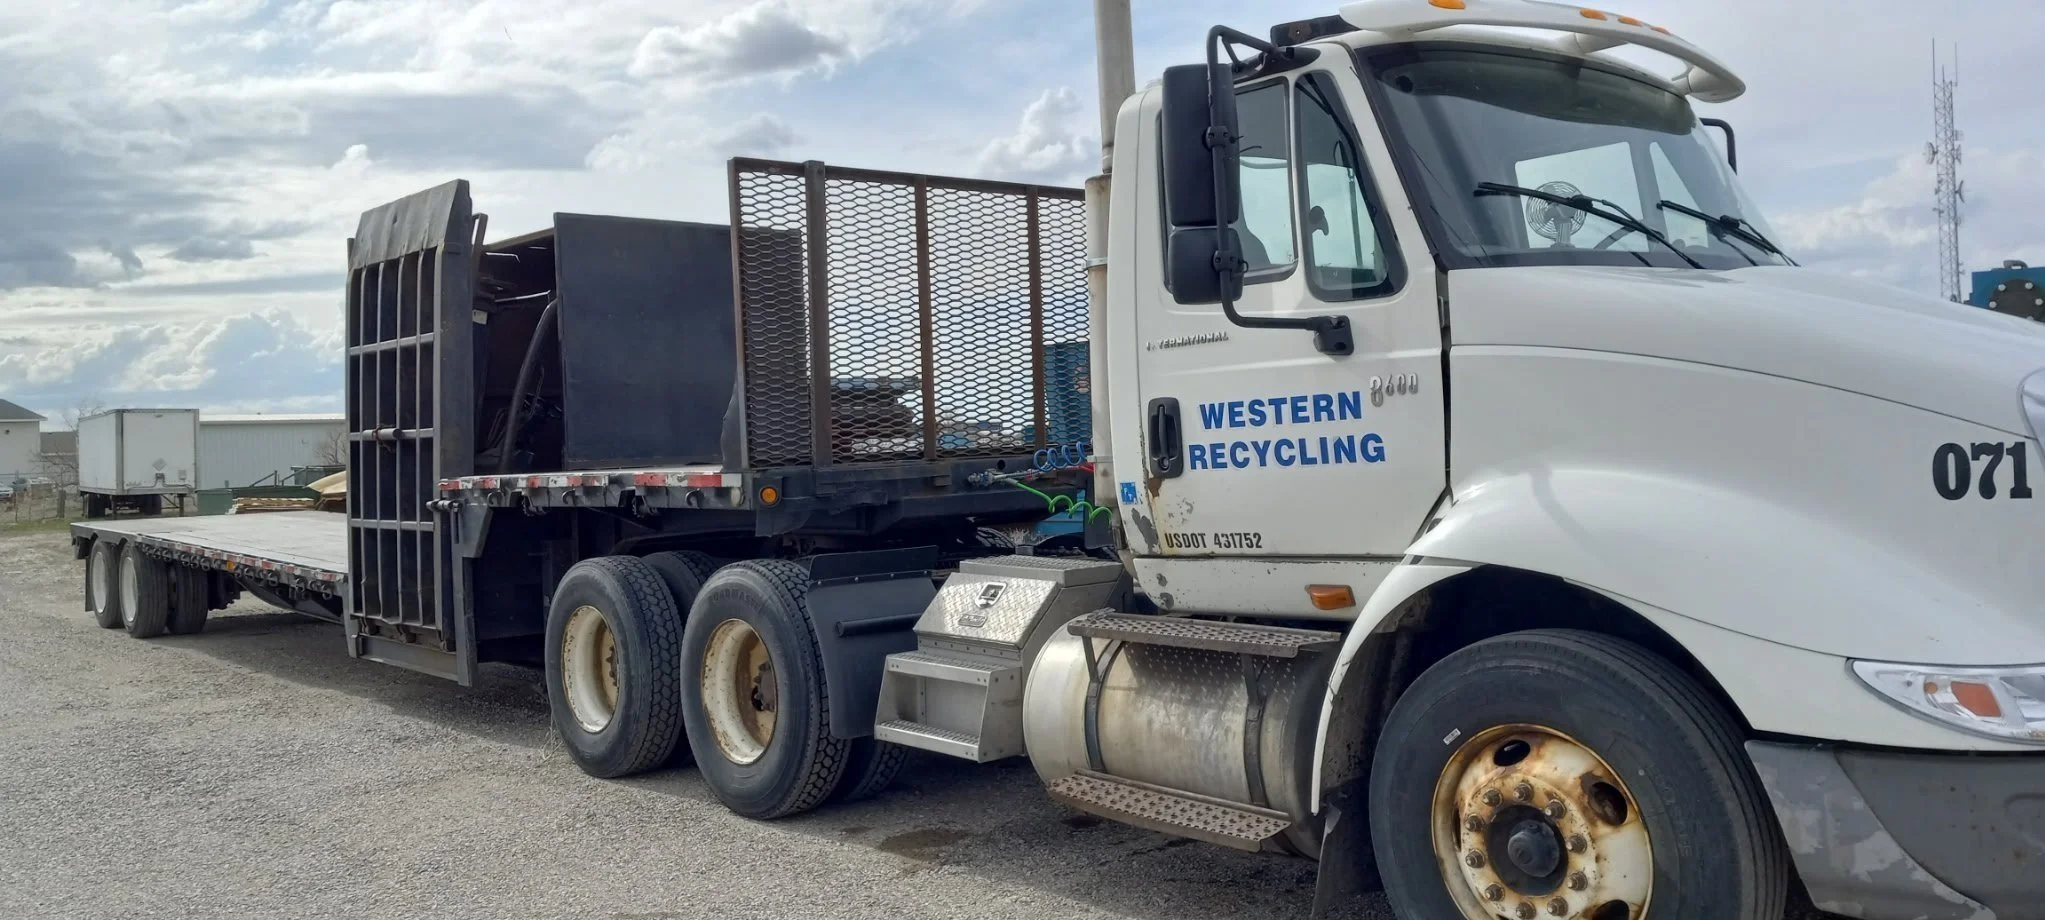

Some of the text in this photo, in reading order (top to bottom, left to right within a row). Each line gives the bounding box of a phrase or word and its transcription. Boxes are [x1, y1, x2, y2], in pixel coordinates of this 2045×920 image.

[1147, 331, 1229, 351] ITERNATIONAL
[1370, 373, 1419, 407] 8600
[1199, 391, 1362, 430] WESTERN
[1188, 433, 1386, 471] RECYCLING
[1932, 441, 2032, 500] 071
[1164, 532, 1263, 549] USDOT 431752
